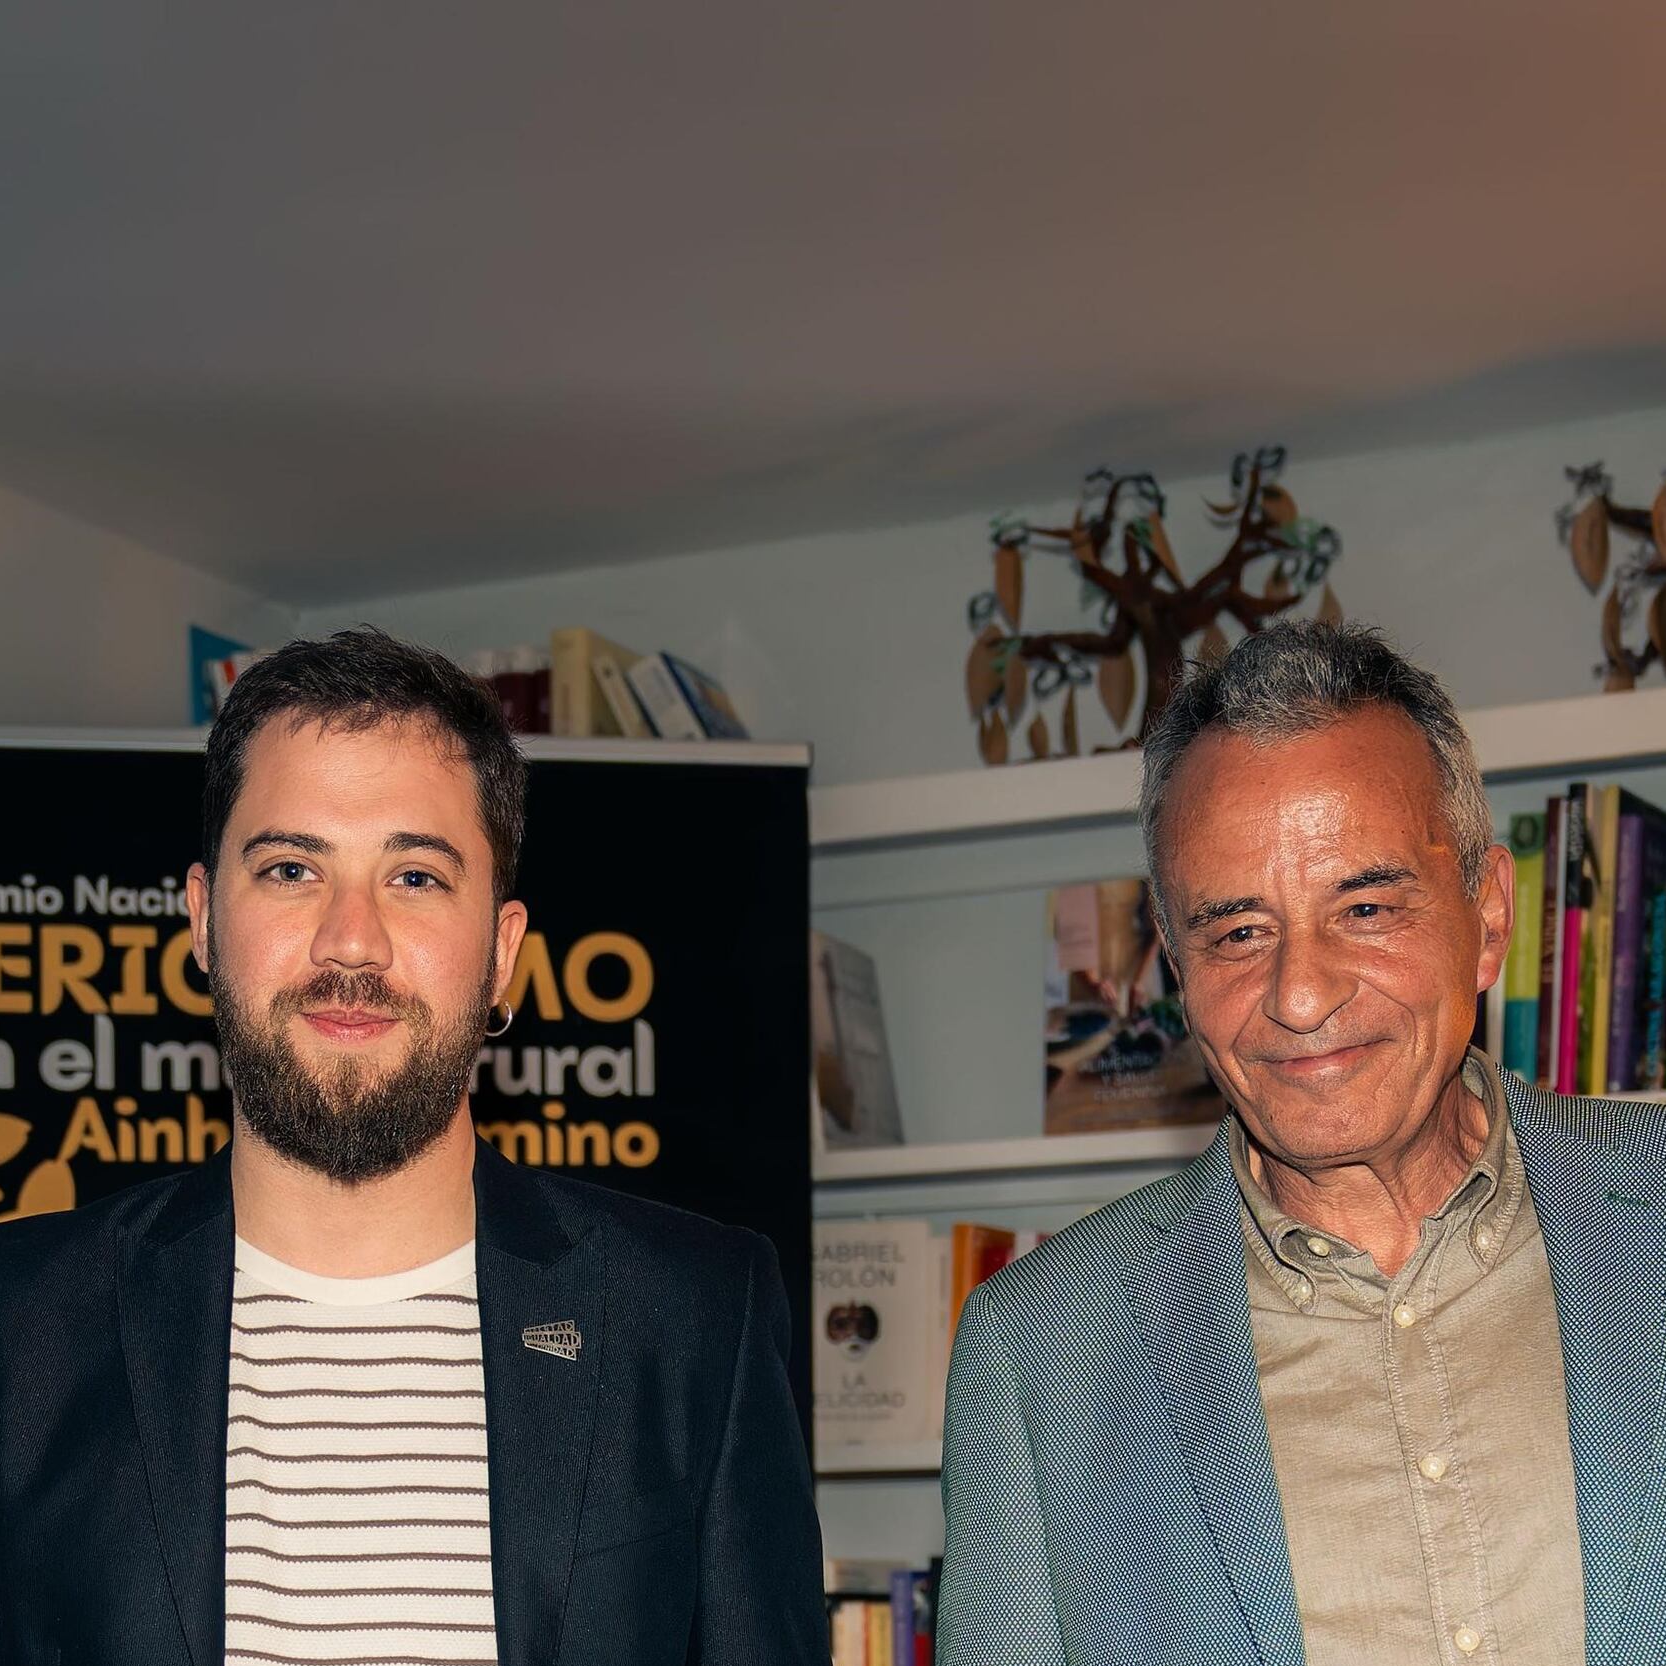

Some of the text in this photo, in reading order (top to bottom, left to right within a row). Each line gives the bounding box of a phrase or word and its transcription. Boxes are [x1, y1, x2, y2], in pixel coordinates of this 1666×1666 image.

[74, 874, 191, 917] Naci
[38, 1014, 115, 1091] el
[468, 1018, 656, 1097] rural
[58, 1095, 660, 1168] Ainh mino
[816, 1391, 906, 1410] ELICIDAD
